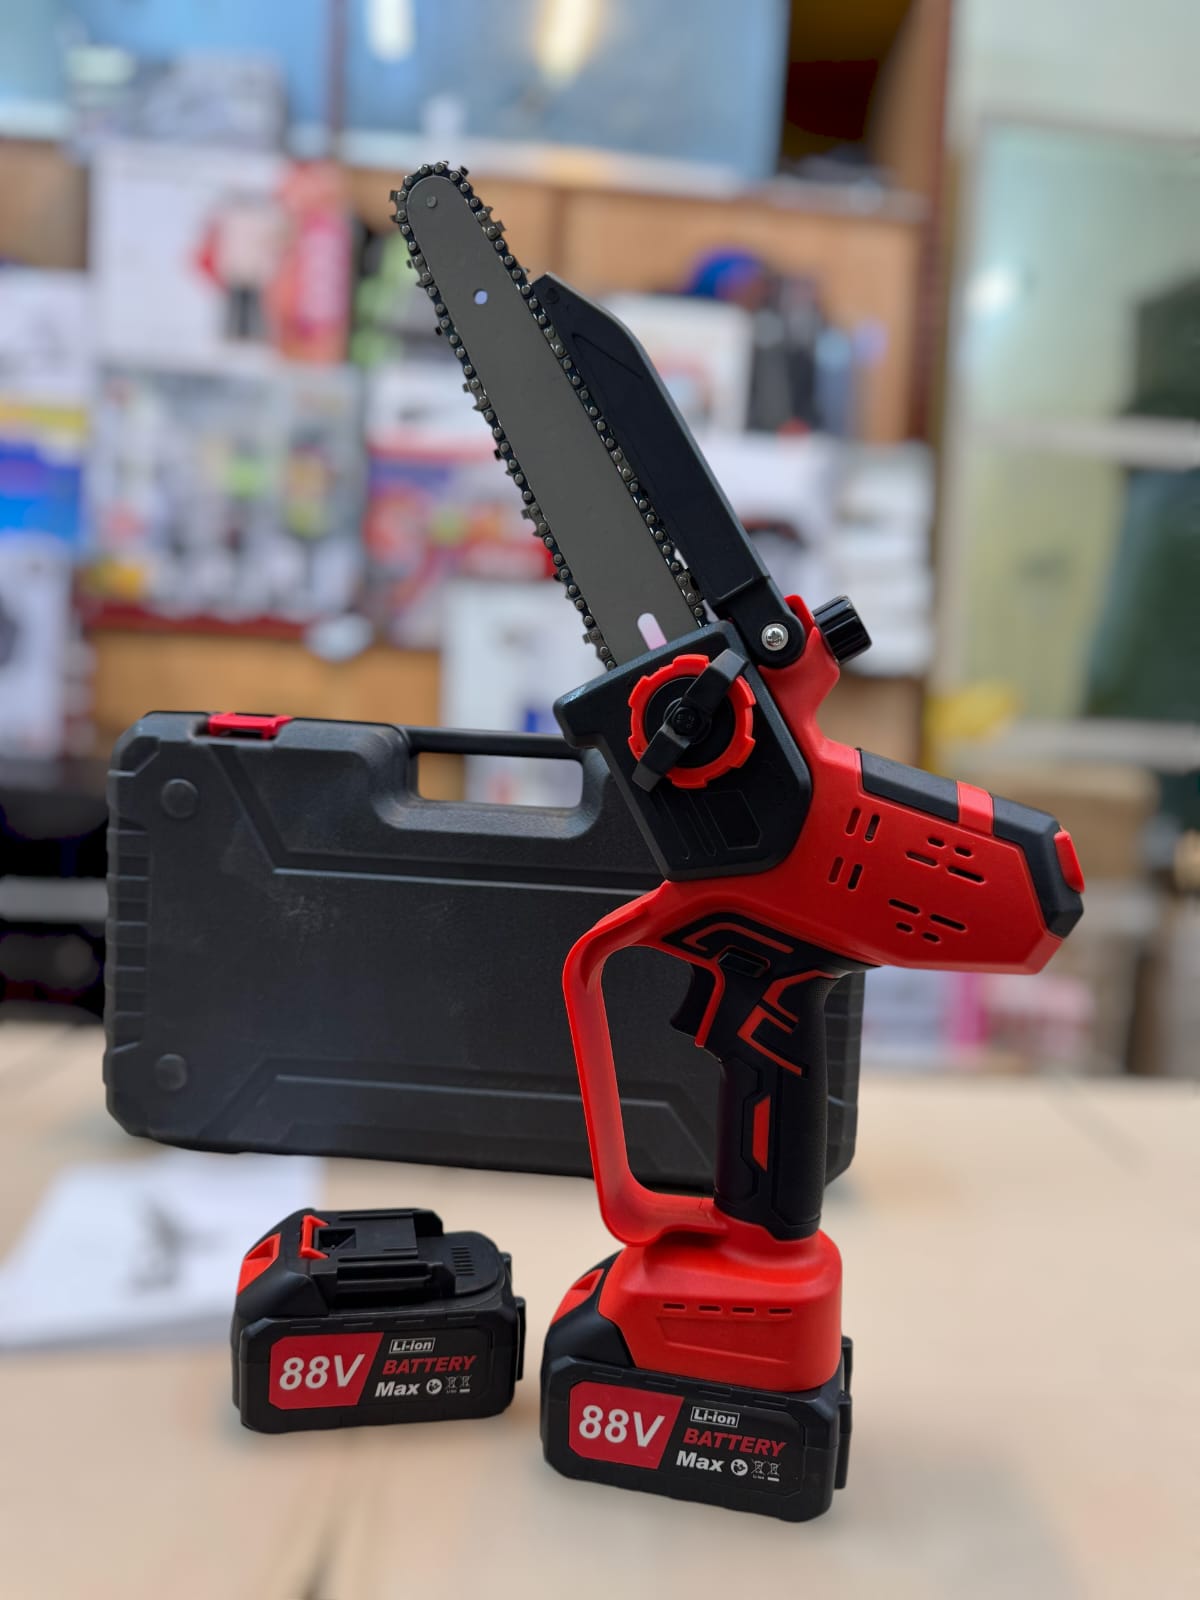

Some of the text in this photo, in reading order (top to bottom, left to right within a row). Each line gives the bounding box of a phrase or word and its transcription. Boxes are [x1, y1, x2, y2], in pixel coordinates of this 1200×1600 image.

[279, 1354, 365, 1391] 88V
[382, 1355, 477, 1375] BATTERY
[375, 1381, 419, 1398] Max
[579, 1405, 665, 1447] 88V
[694, 1407, 737, 1425] Li-ion
[683, 1428, 786, 1457] BATTERY
[676, 1450, 724, 1472] Max
